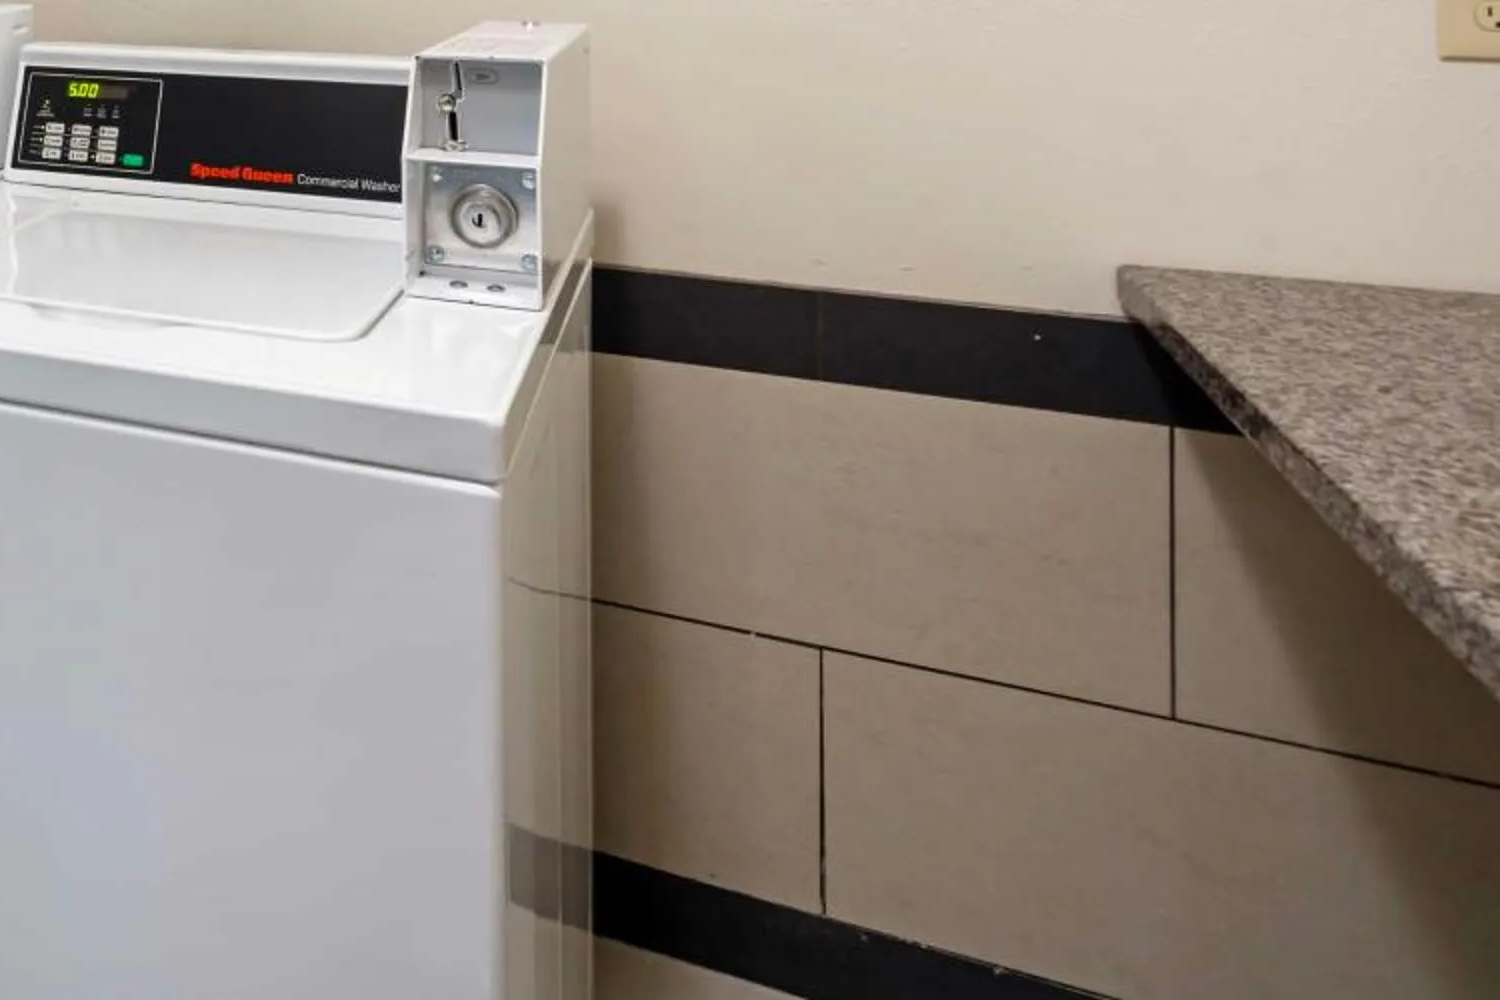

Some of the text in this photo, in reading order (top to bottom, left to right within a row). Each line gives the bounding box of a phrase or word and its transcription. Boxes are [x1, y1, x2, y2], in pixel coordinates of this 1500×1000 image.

[191, 162, 239, 180] Speed
[242, 166, 293, 184] Queen
[297, 173, 359, 190] Commercial
